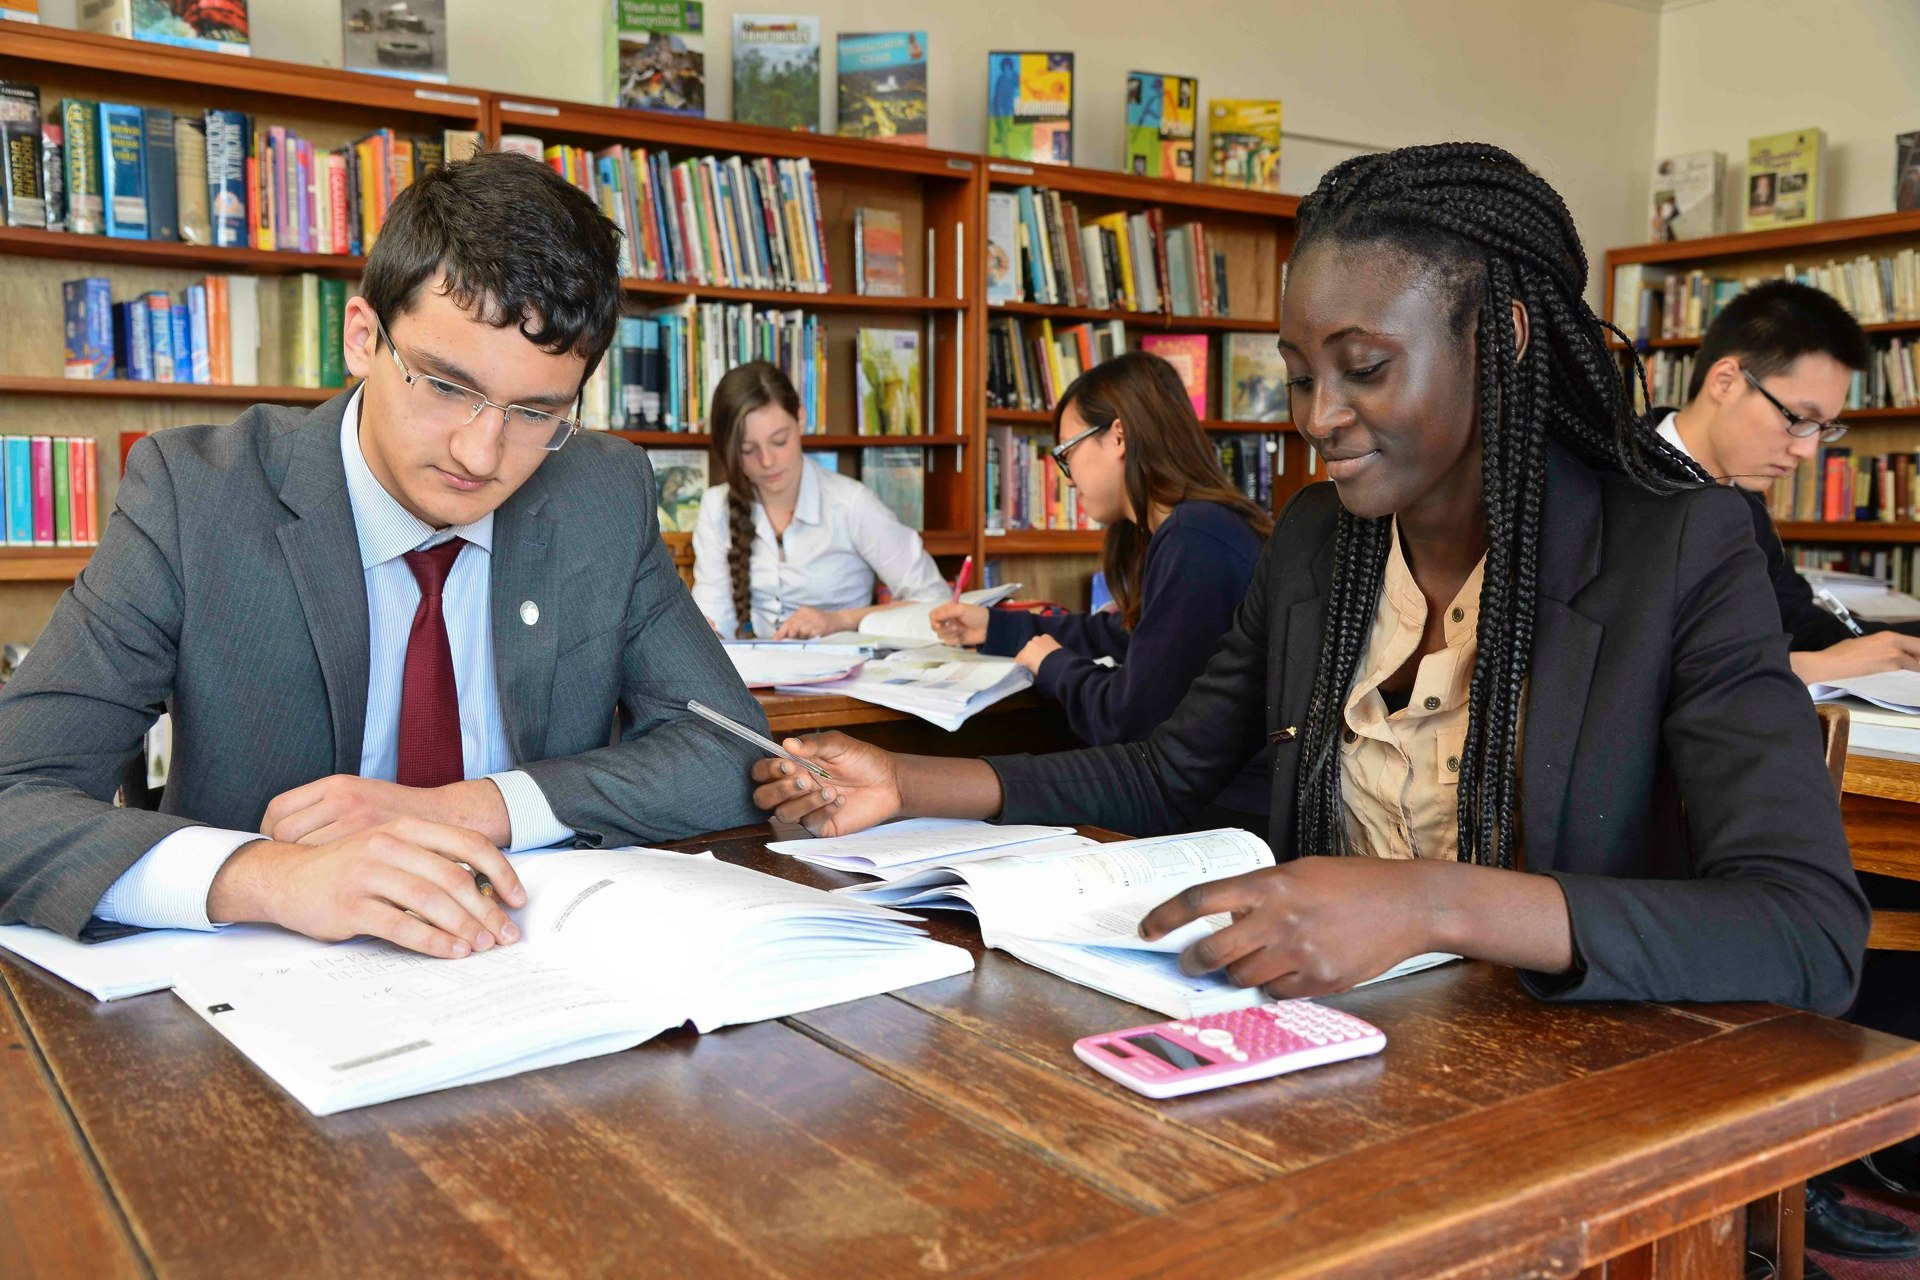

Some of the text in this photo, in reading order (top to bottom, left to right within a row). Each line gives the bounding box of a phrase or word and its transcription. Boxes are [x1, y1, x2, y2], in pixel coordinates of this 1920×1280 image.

[626, 15, 680, 28] Recycling
[659, 3, 680, 14] and
[10, 140, 25, 197] DICTIONA
[21, 135, 37, 198] BIOGRAPHI
